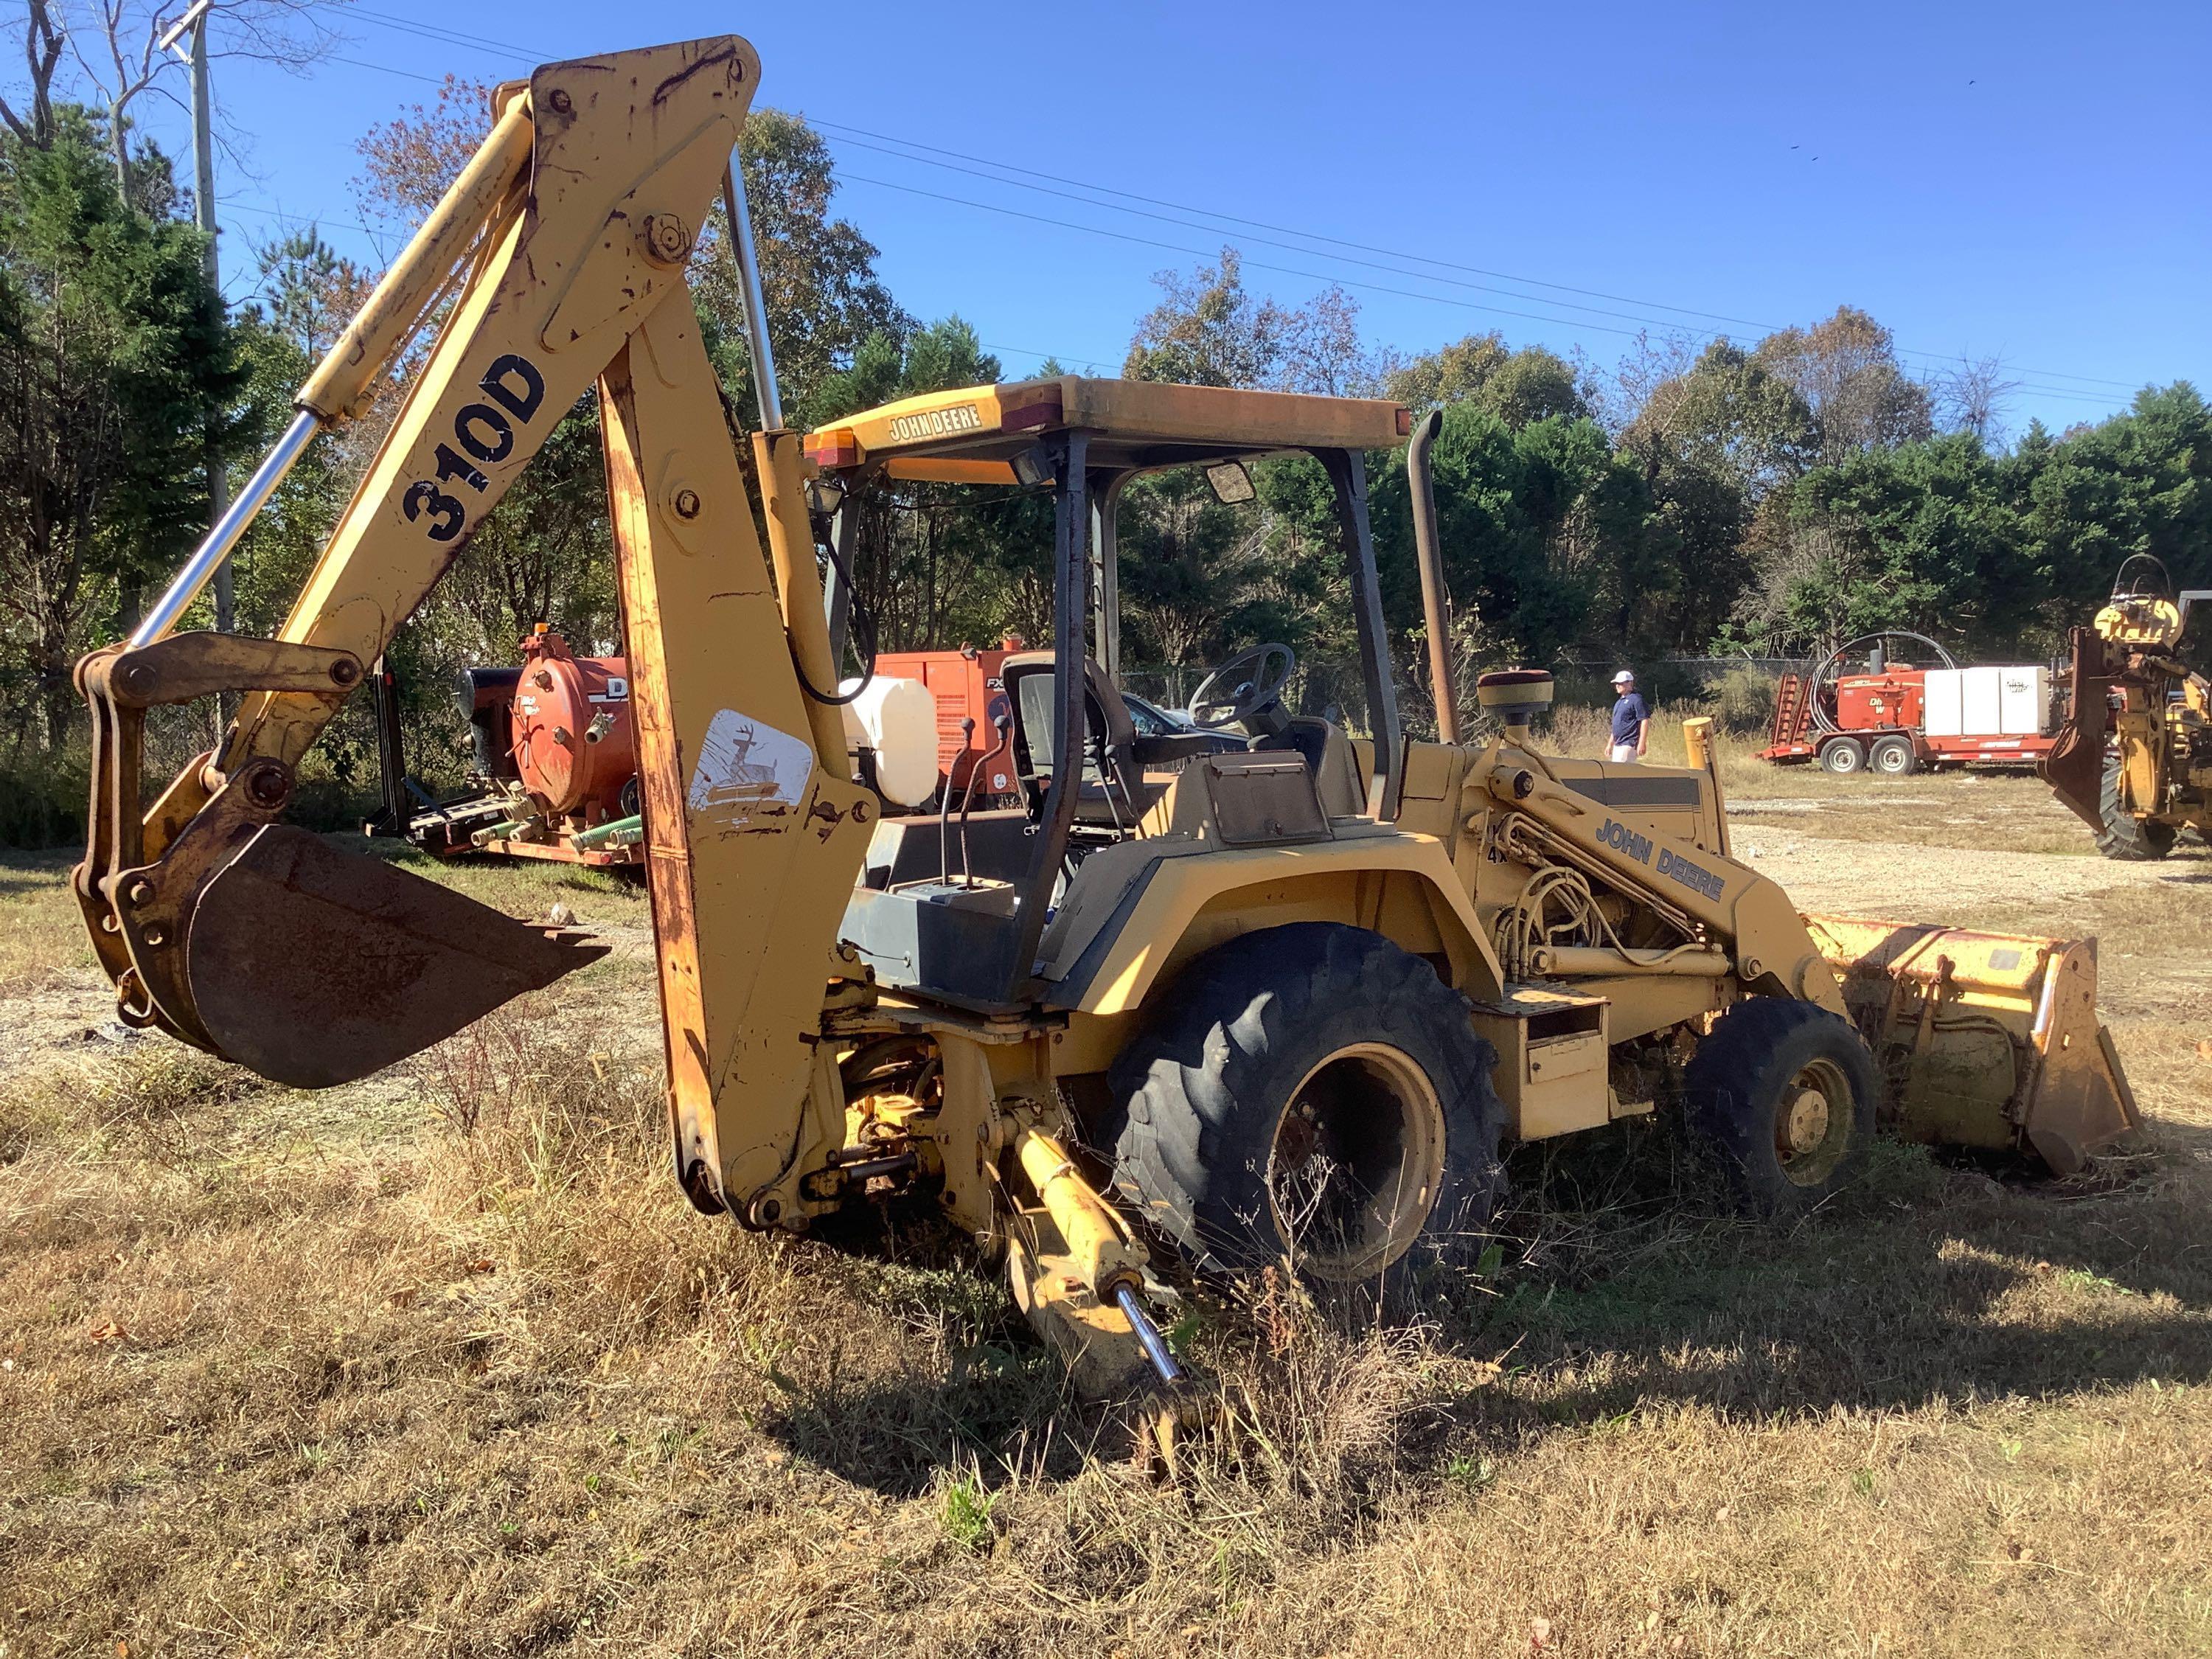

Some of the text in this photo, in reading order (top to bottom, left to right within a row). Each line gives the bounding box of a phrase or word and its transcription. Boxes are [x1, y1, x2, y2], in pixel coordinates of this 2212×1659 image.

[403, 354, 546, 542] 310D
[889, 404, 982, 442] JOHN DEERE
[1596, 817, 1725, 903] JOHN DEERE
